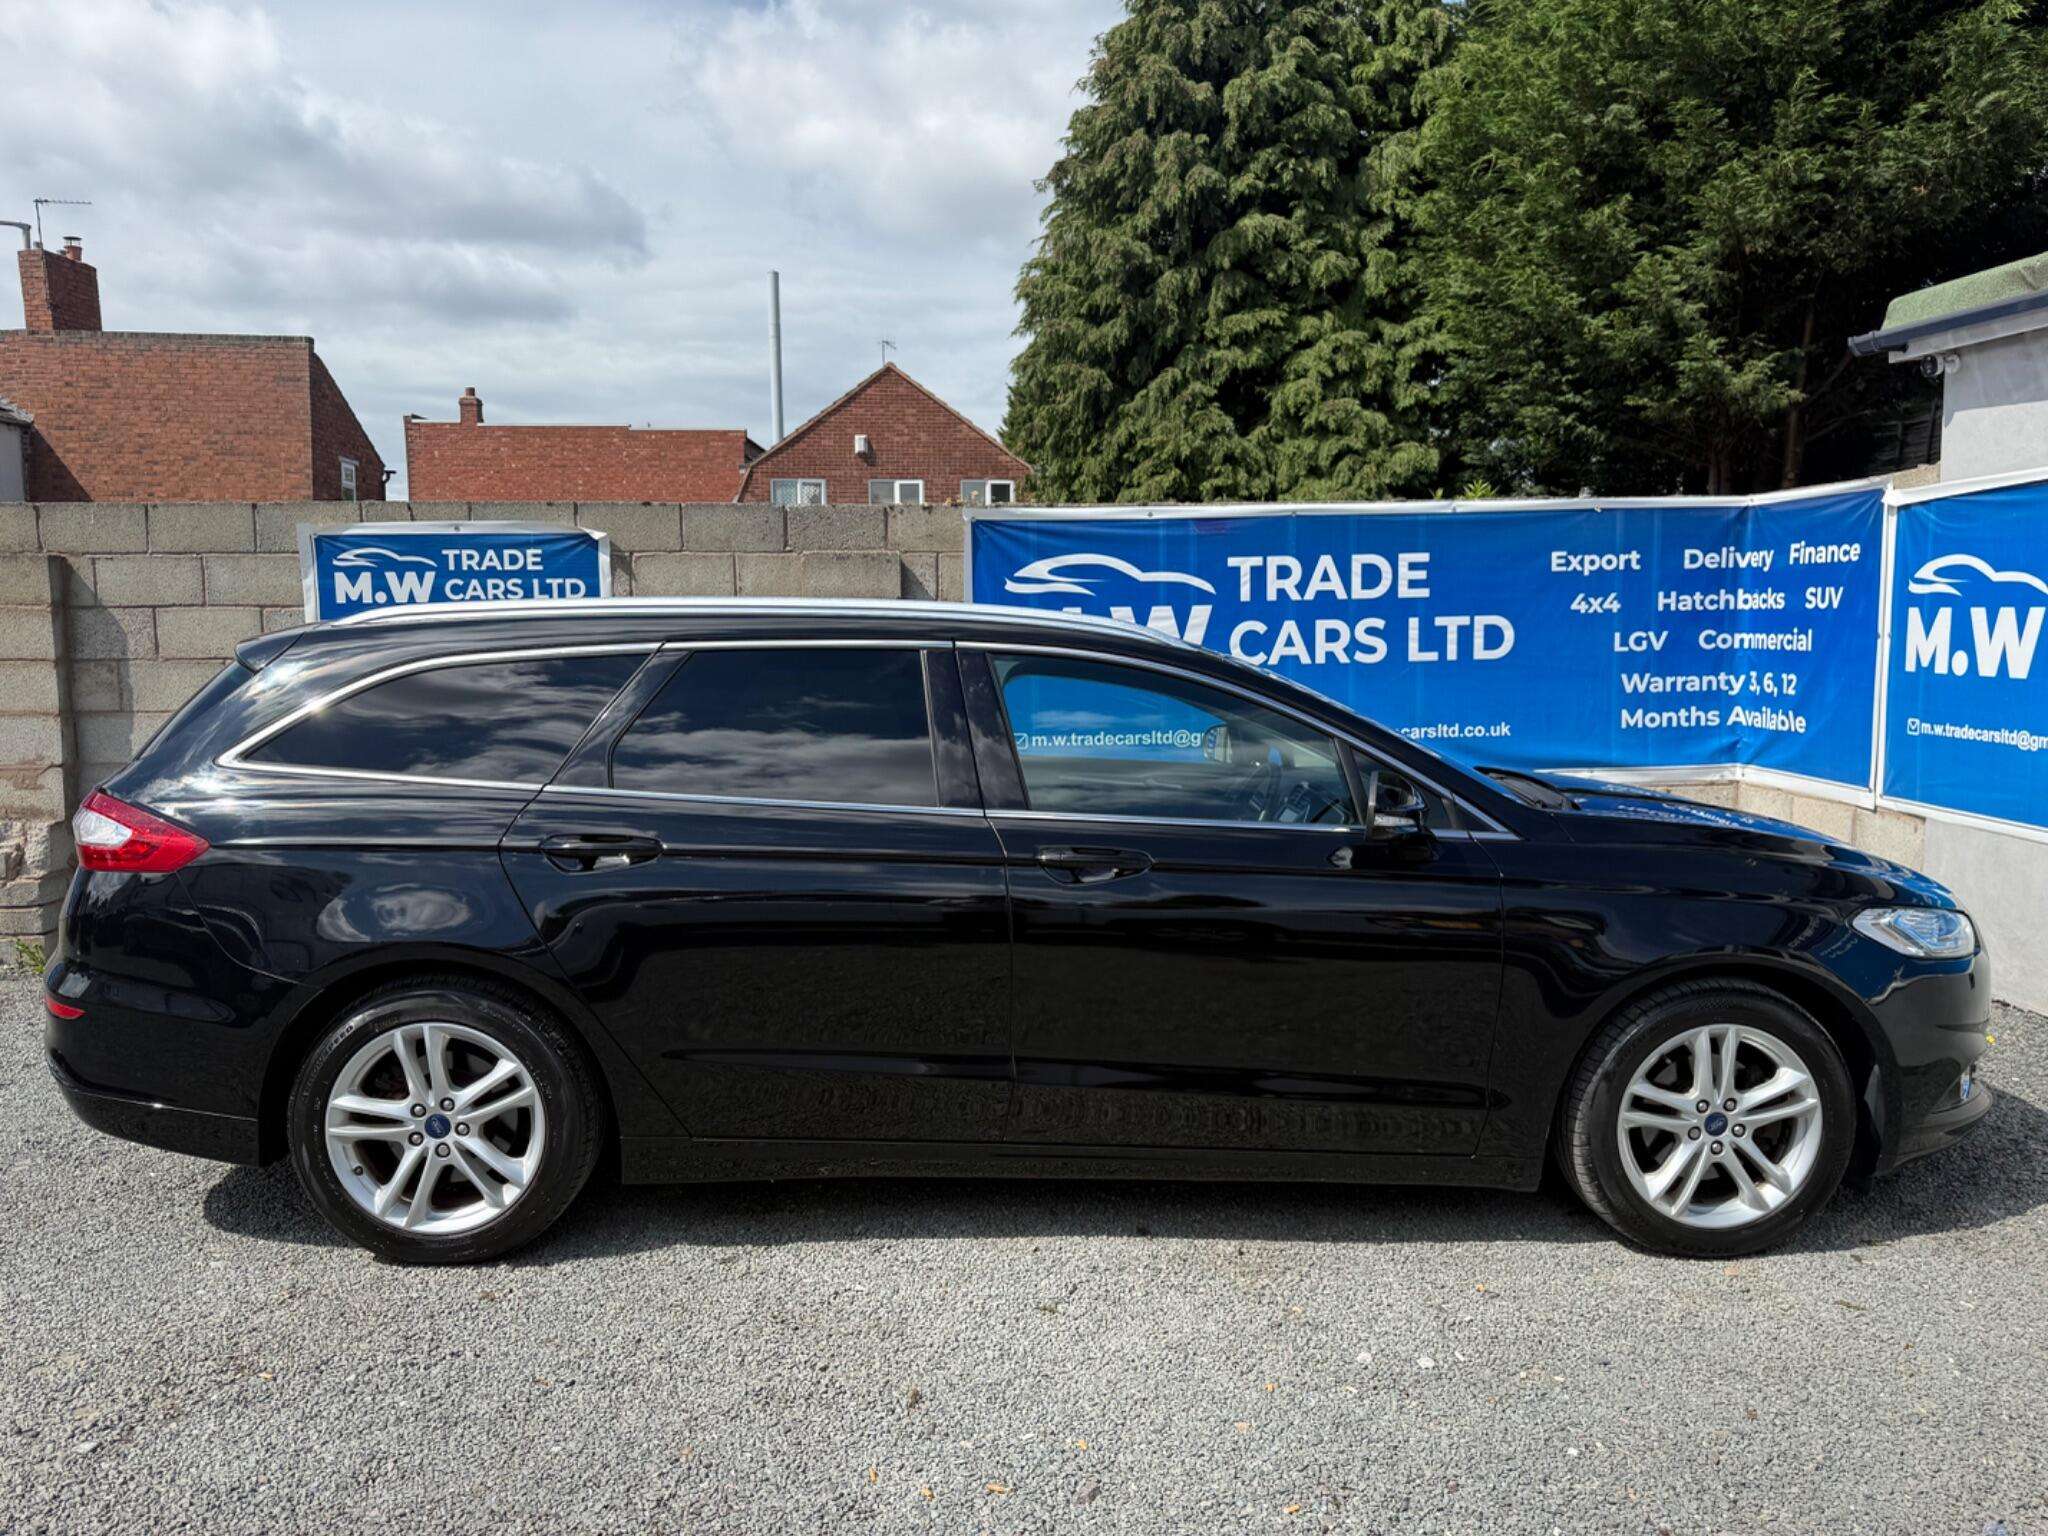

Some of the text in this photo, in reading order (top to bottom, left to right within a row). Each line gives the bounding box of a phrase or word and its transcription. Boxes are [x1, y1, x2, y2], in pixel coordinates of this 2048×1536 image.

[442, 548, 544, 572] TRADE
[1550, 540, 1861, 576] Export Delivery Finance
[333, 570, 436, 605] M.W
[444, 577, 586, 601] CARS LTD
[1227, 551, 1431, 602] TRADE
[1569, 586, 1844, 614] 4x4 Hatchbacks SUV
[1229, 616, 1388, 666] CARS
[1407, 614, 1516, 662] LTD
[1613, 627, 1813, 653] LGV Commercial
[1905, 606, 2047, 680] M.W
[1621, 671, 1746, 696] Warranty
[1396, 721, 1512, 740] carsltd.co.uk
[1621, 704, 1807, 734] Months Available
